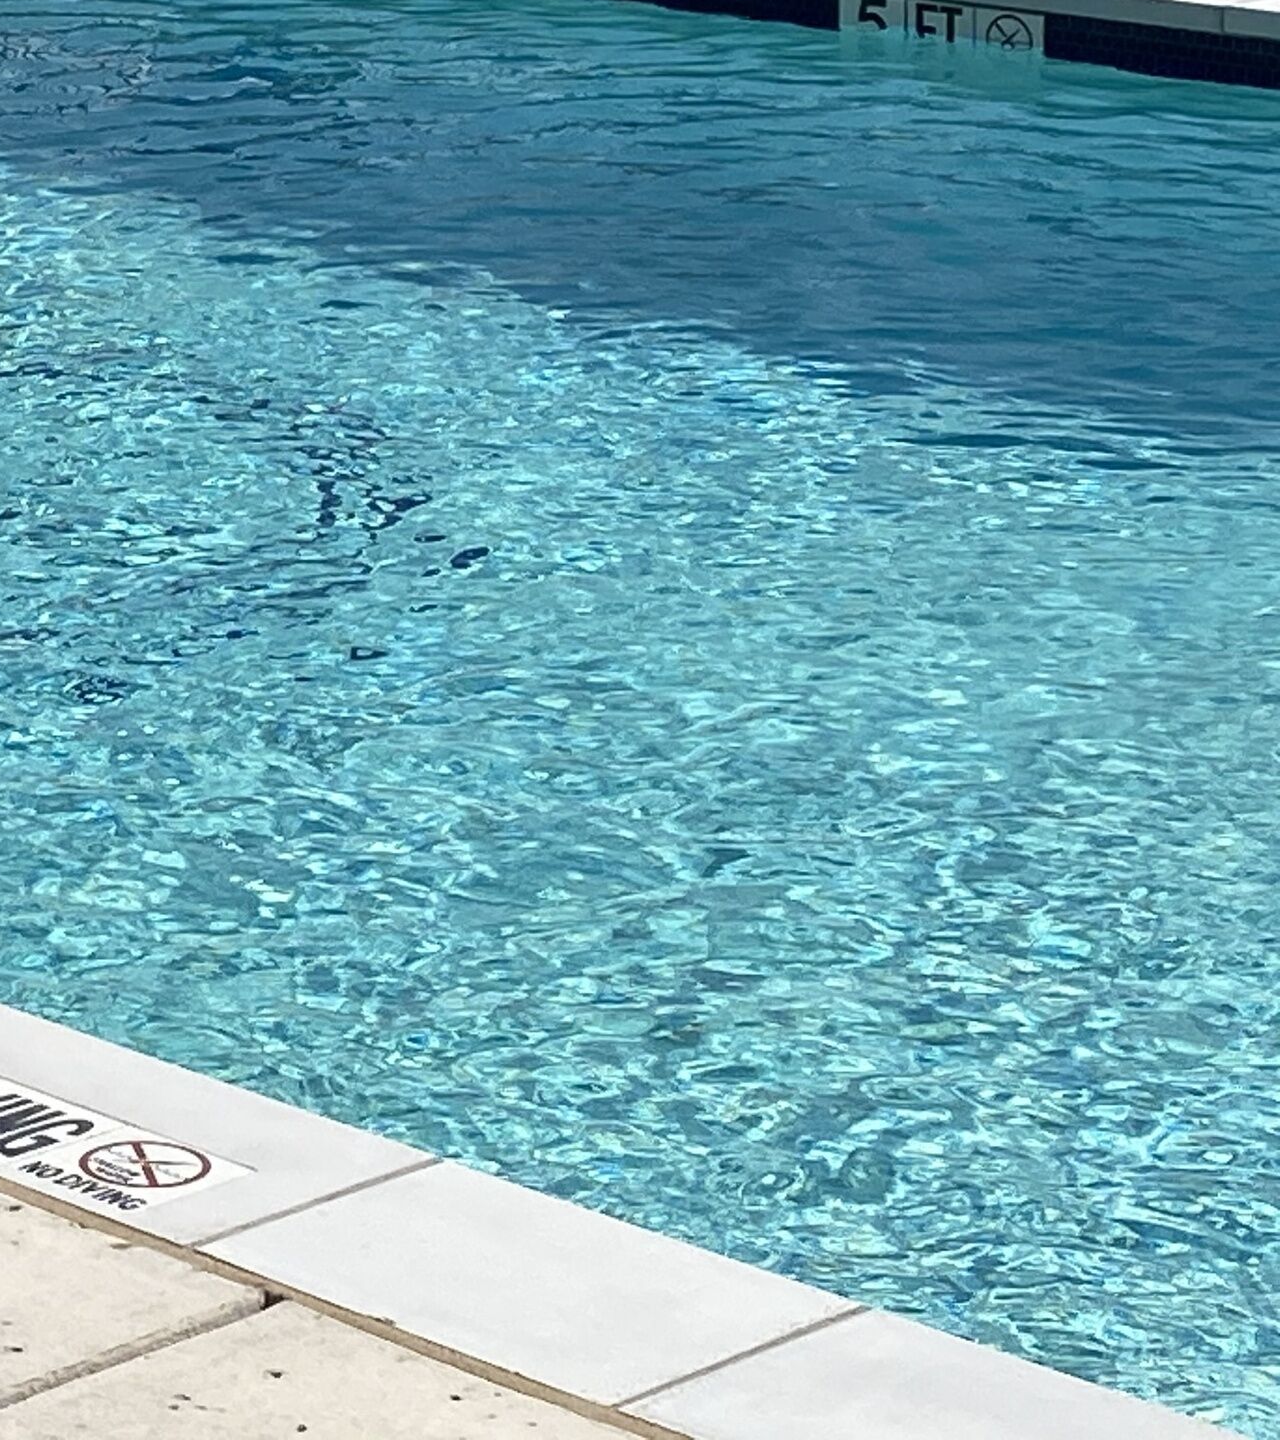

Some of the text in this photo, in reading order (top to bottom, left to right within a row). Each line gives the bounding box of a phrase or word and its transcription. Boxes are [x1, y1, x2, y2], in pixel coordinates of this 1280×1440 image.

[915, 3, 963, 44] FT
[19, 1160, 148, 1211] NO DIVING
